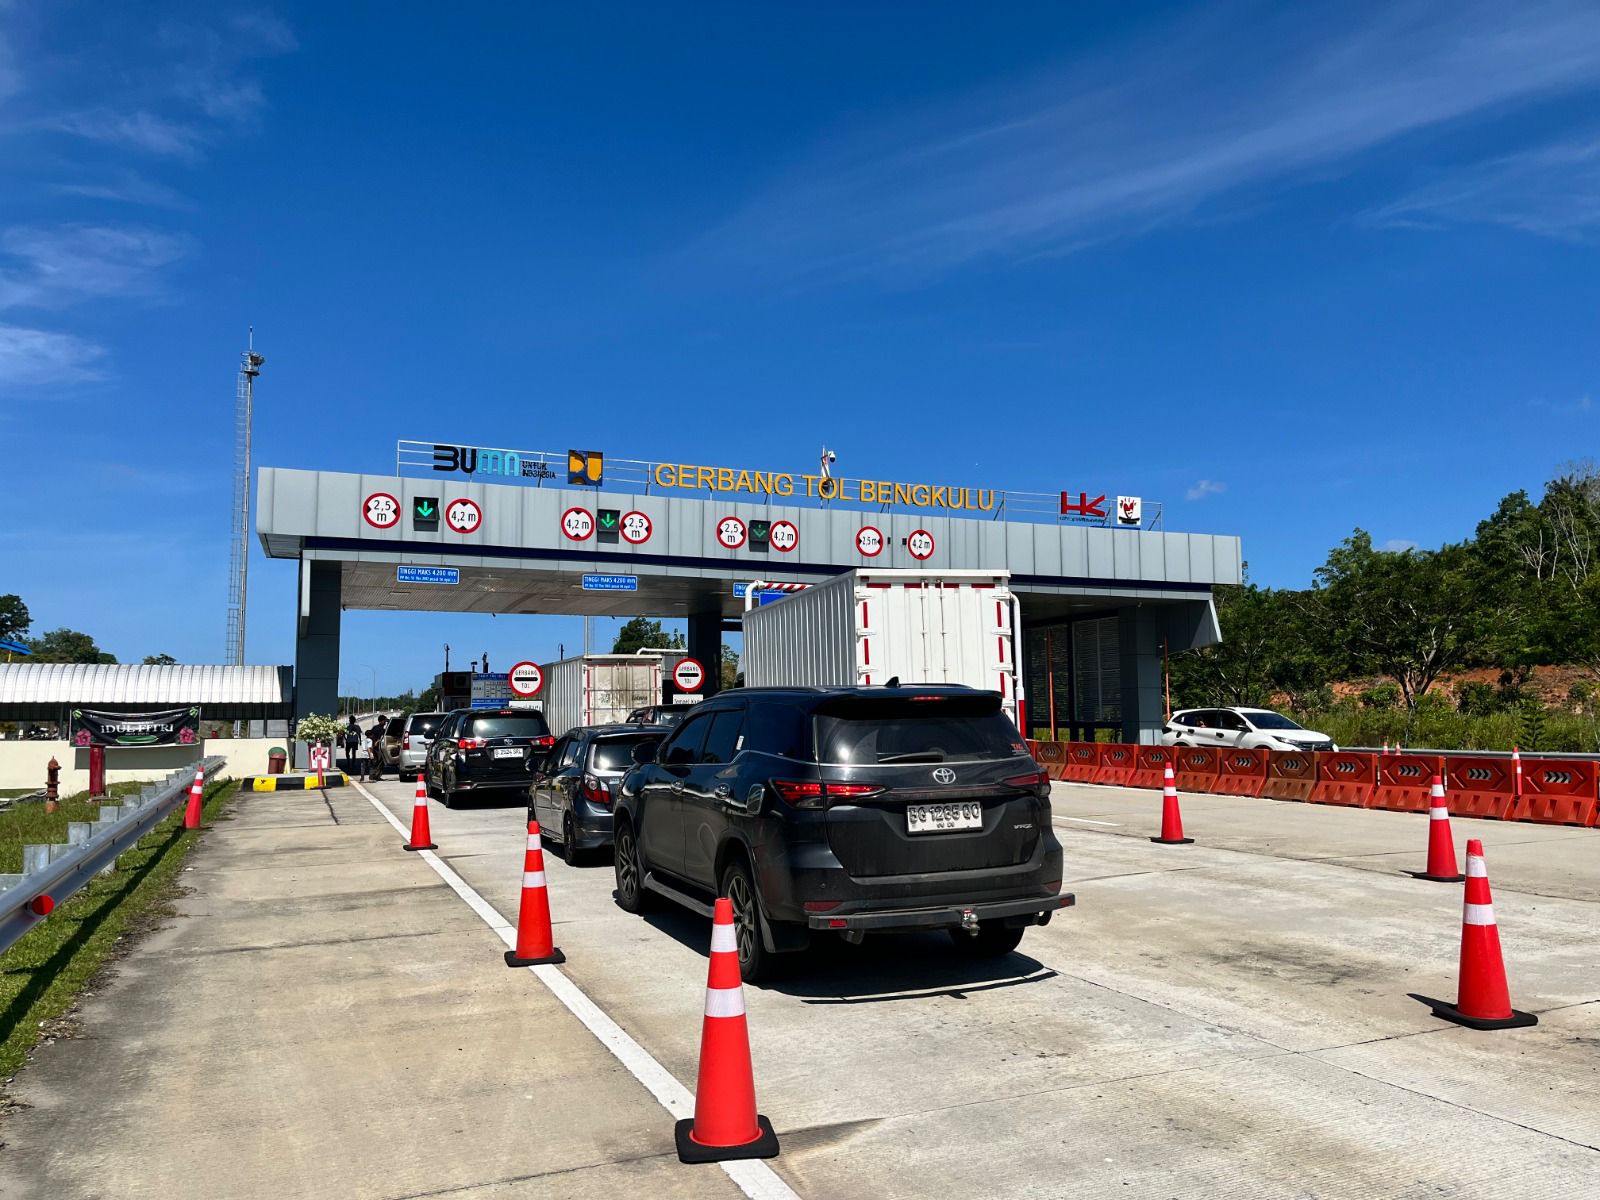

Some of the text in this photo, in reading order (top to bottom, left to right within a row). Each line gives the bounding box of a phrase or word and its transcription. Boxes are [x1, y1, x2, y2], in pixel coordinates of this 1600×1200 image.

[655, 463, 994, 510] GERBANG TOL BENGKULU
[374, 500, 391, 512] 2,5
[1061, 491, 1106, 517] HK
[376, 512, 387, 521] m
[451, 510, 476, 522] 4,2 m
[566, 519, 589, 530] 4,2 m
[629, 518, 643, 529] 2,5
[724, 523, 739, 534] 2,5
[631, 529, 640, 538] m
[727, 534, 735, 543] m
[774, 531, 794, 542] 4,2 m
[862, 536, 878, 546] 2,5 m
[912, 539, 930, 549] 4,2 m
[101, 723, 174, 734] IDUL FITRI
